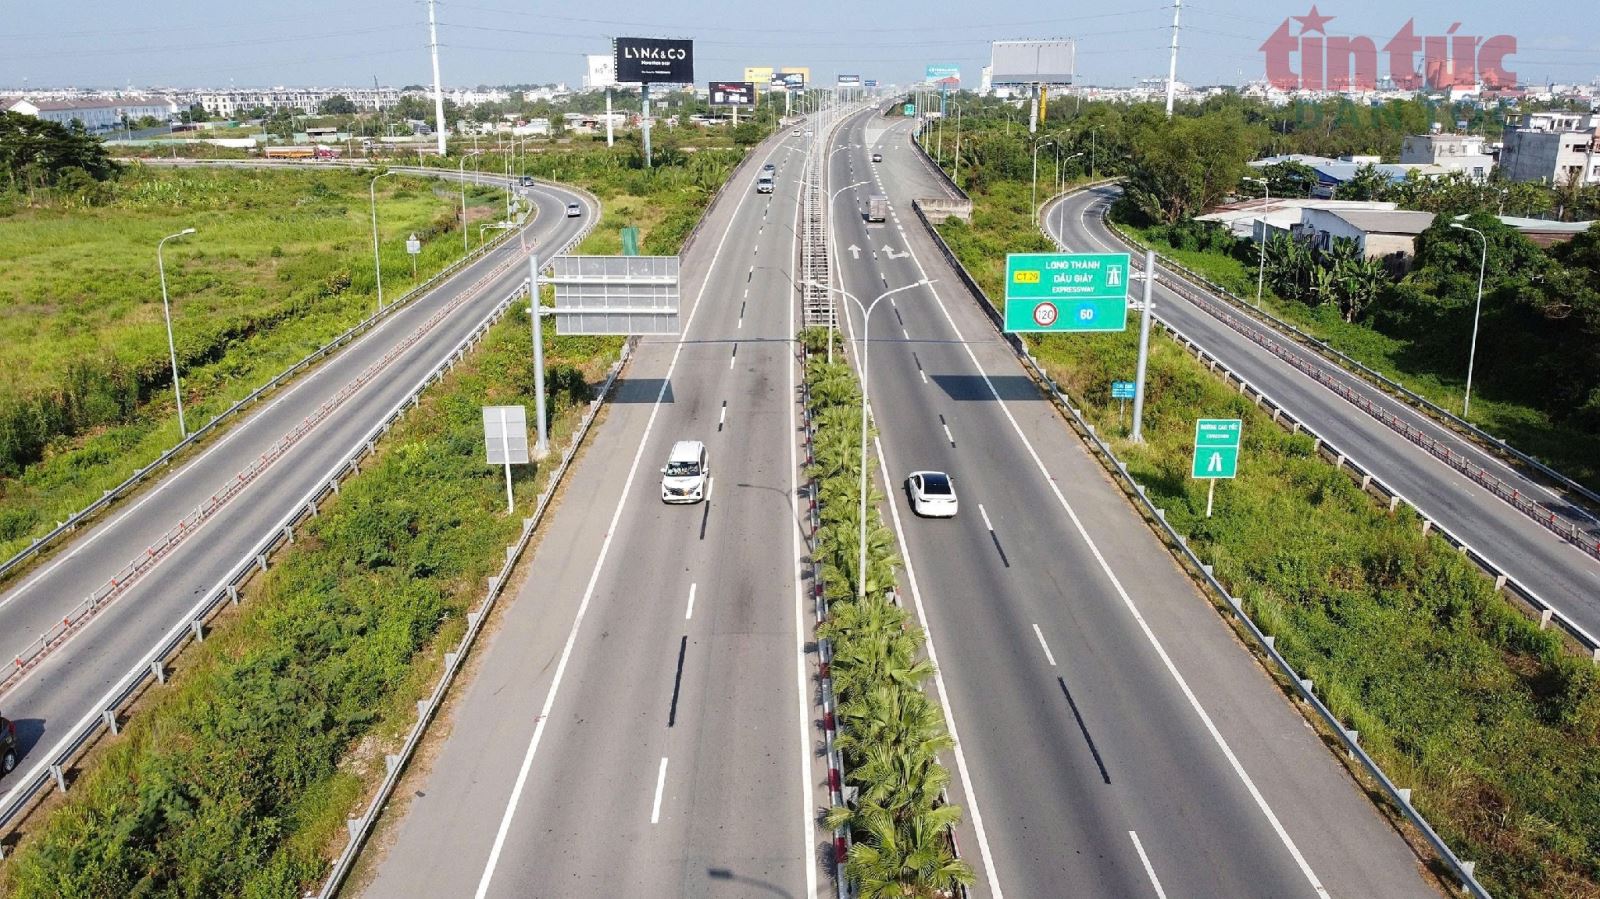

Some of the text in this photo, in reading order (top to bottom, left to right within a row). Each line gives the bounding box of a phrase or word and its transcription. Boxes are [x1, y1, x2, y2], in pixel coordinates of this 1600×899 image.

[1045, 260, 1069, 269] LONG
[1038, 309, 1053, 320] 120
[1080, 308, 1094, 320] 60
